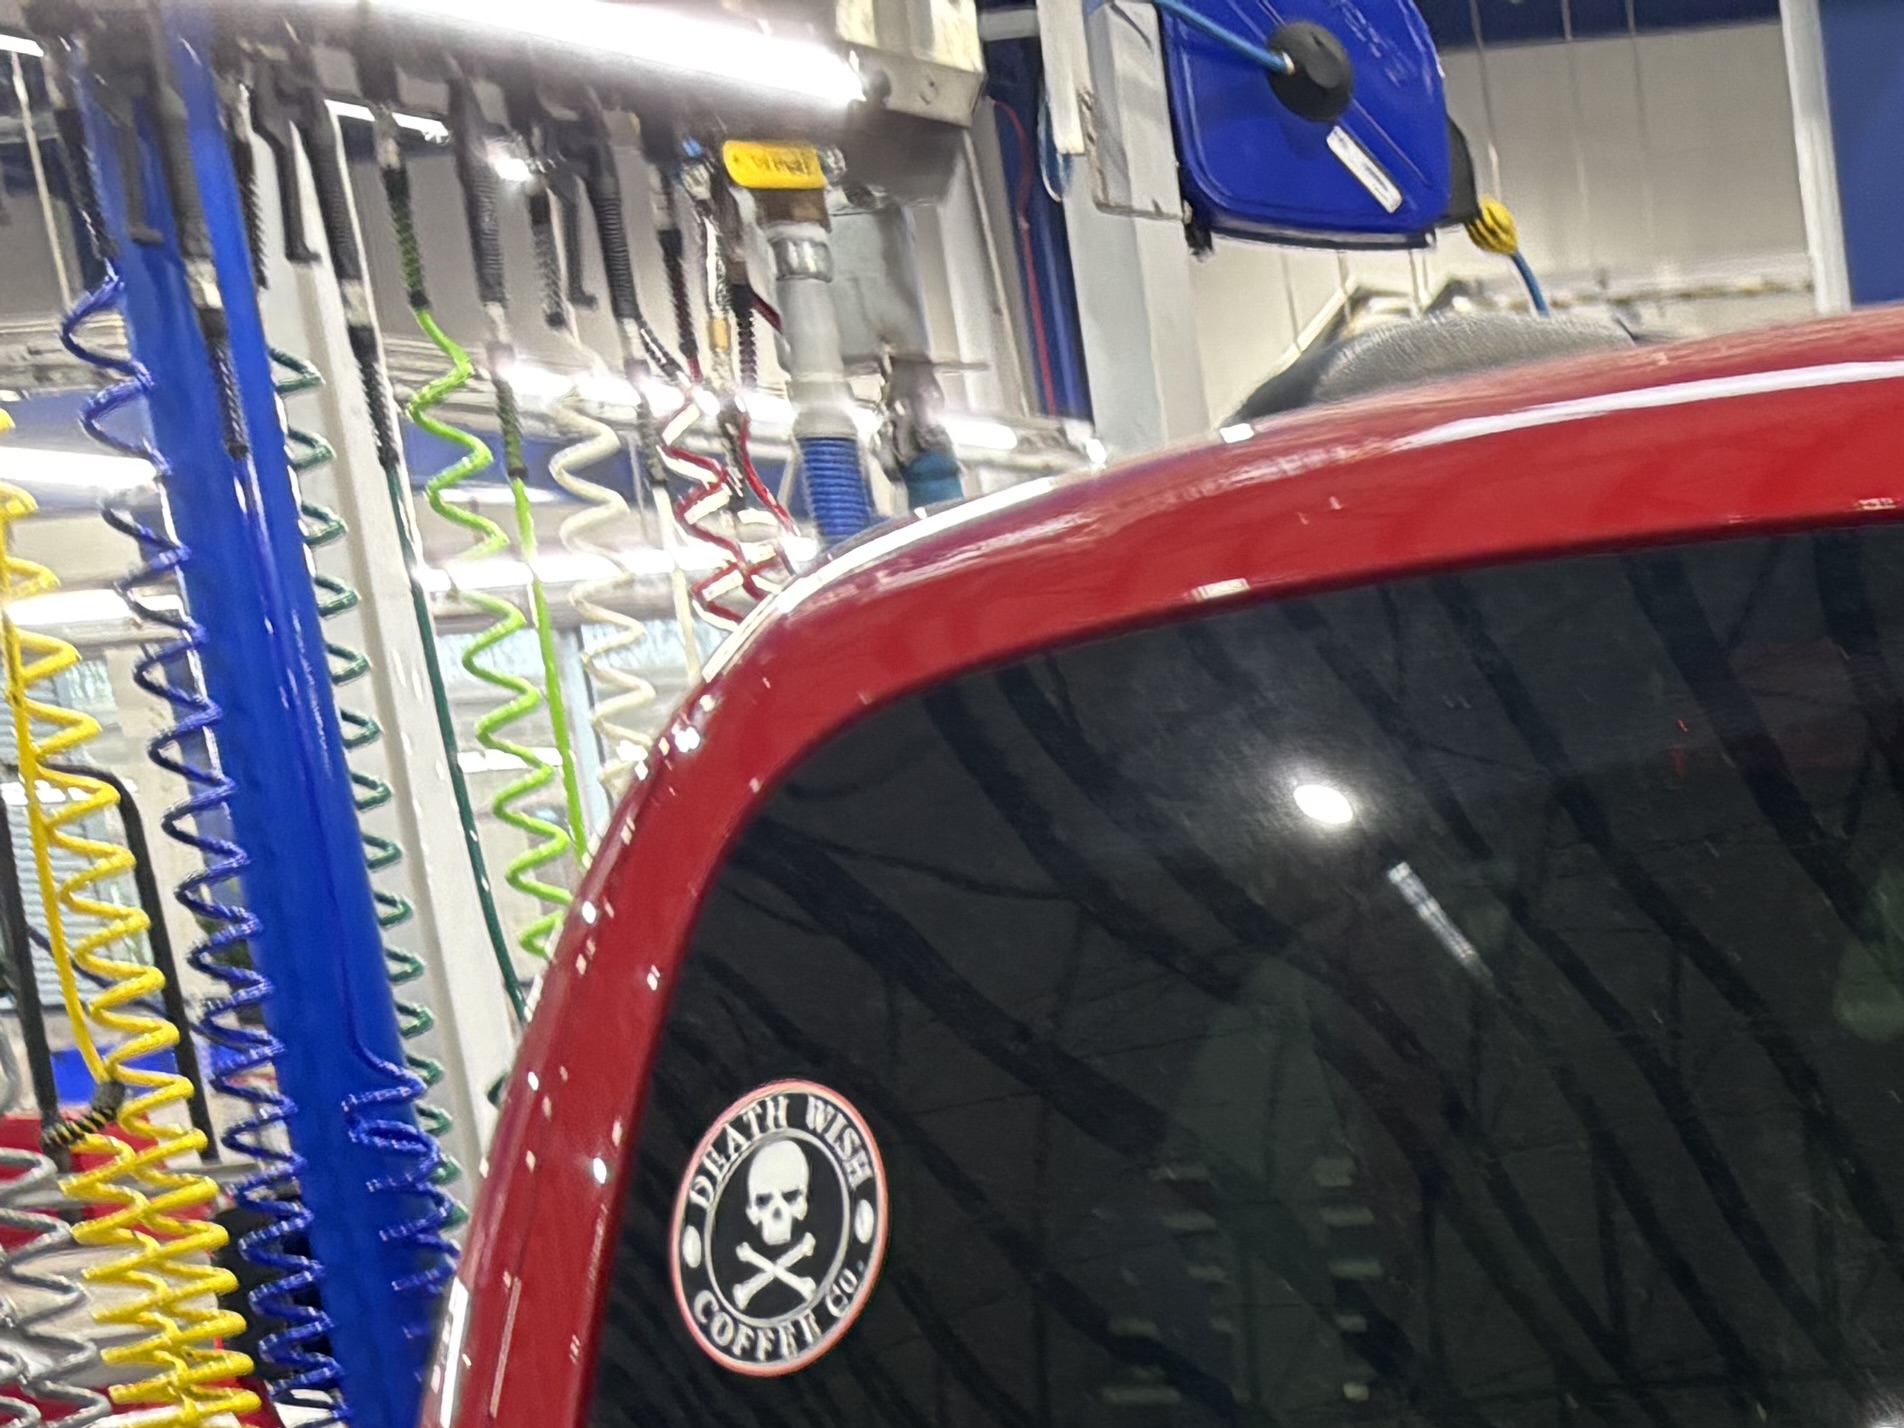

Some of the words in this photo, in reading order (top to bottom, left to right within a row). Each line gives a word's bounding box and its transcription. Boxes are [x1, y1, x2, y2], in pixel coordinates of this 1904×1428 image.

[689, 1095, 789, 1210] DEATH
[806, 1095, 874, 1191] WISH
[693, 1289, 822, 1361] COFFEE
